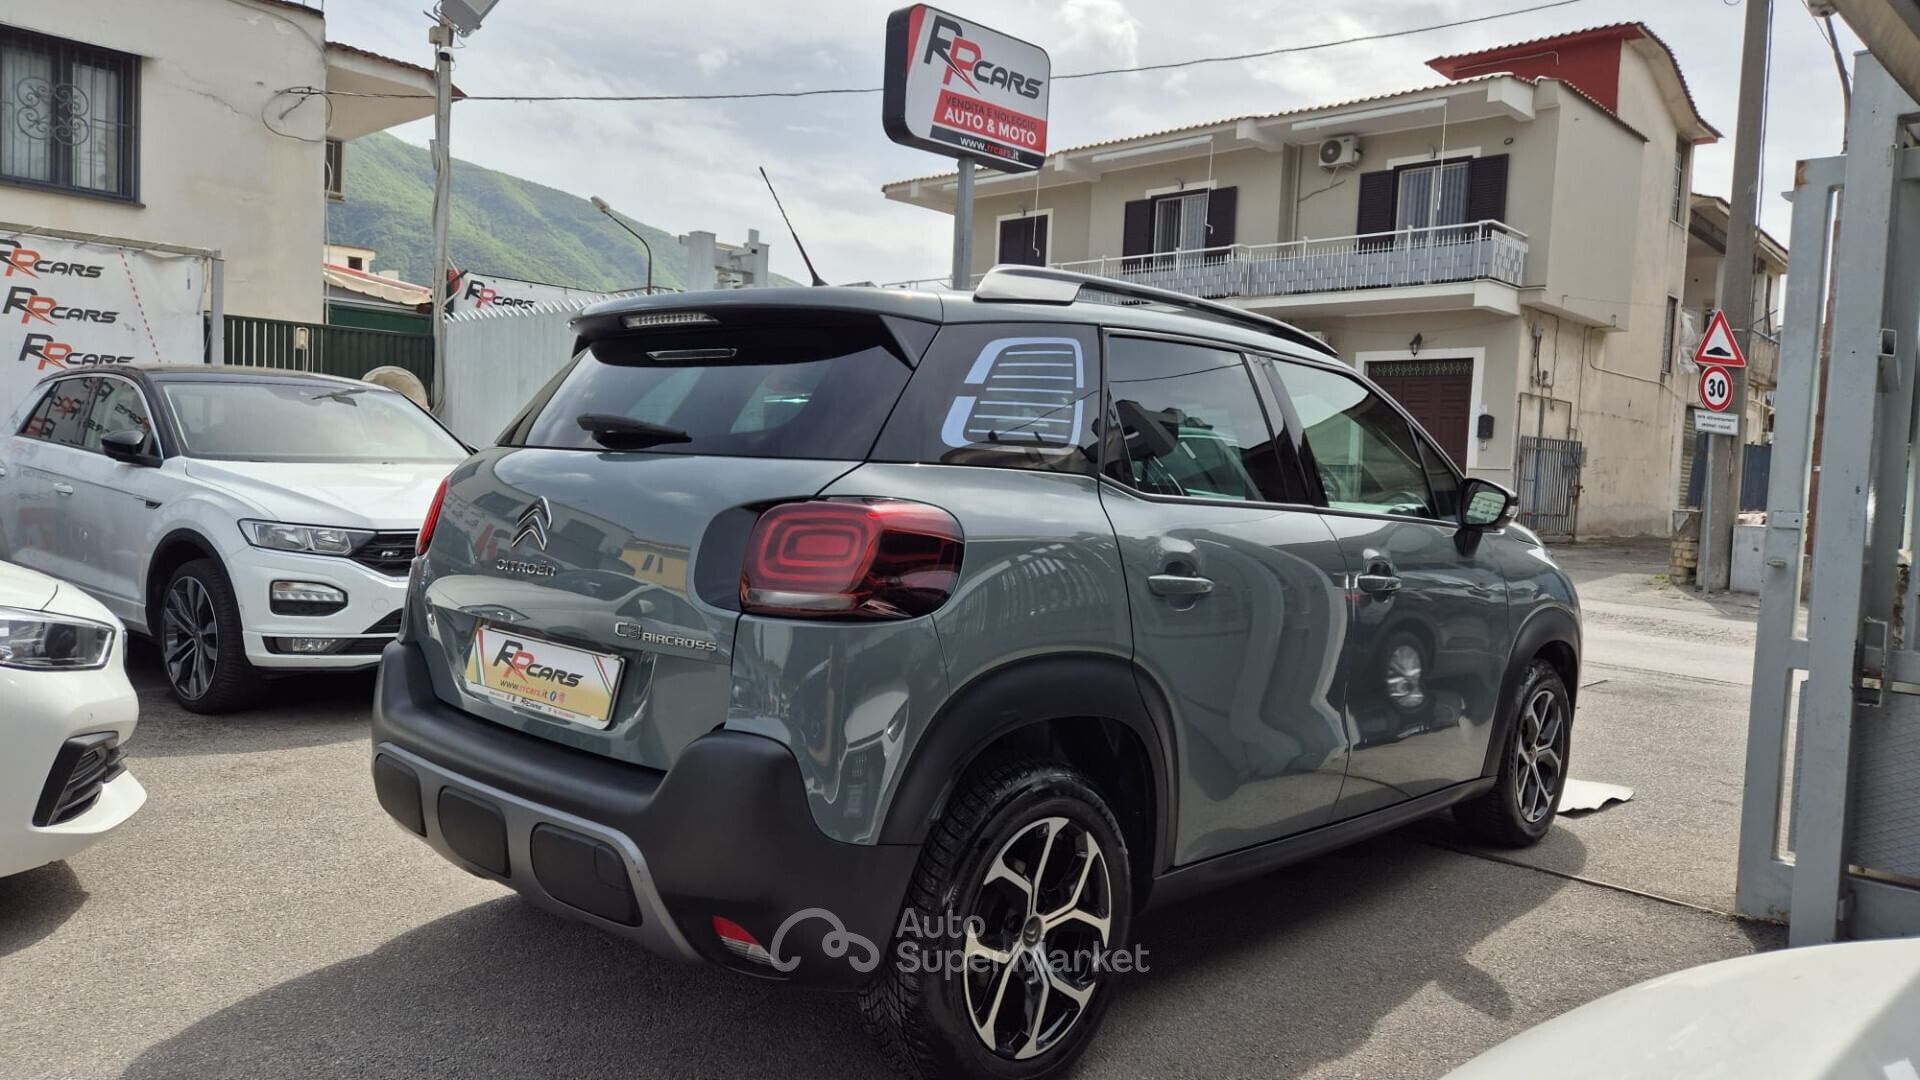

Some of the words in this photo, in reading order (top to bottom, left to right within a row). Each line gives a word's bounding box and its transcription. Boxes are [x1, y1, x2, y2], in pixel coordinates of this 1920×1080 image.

[945, 96, 984, 116] VENDITA
[944, 107, 983, 129] AUTO
[987, 118, 995, 133] &
[999, 122, 1037, 145] MOTO
[960, 137, 1019, 160] www.rrcars.it
[1708, 379, 1726, 398] 30
[642, 632, 718, 652] AIRCROSS
[500, 680, 548, 699] www.rrcars.it
